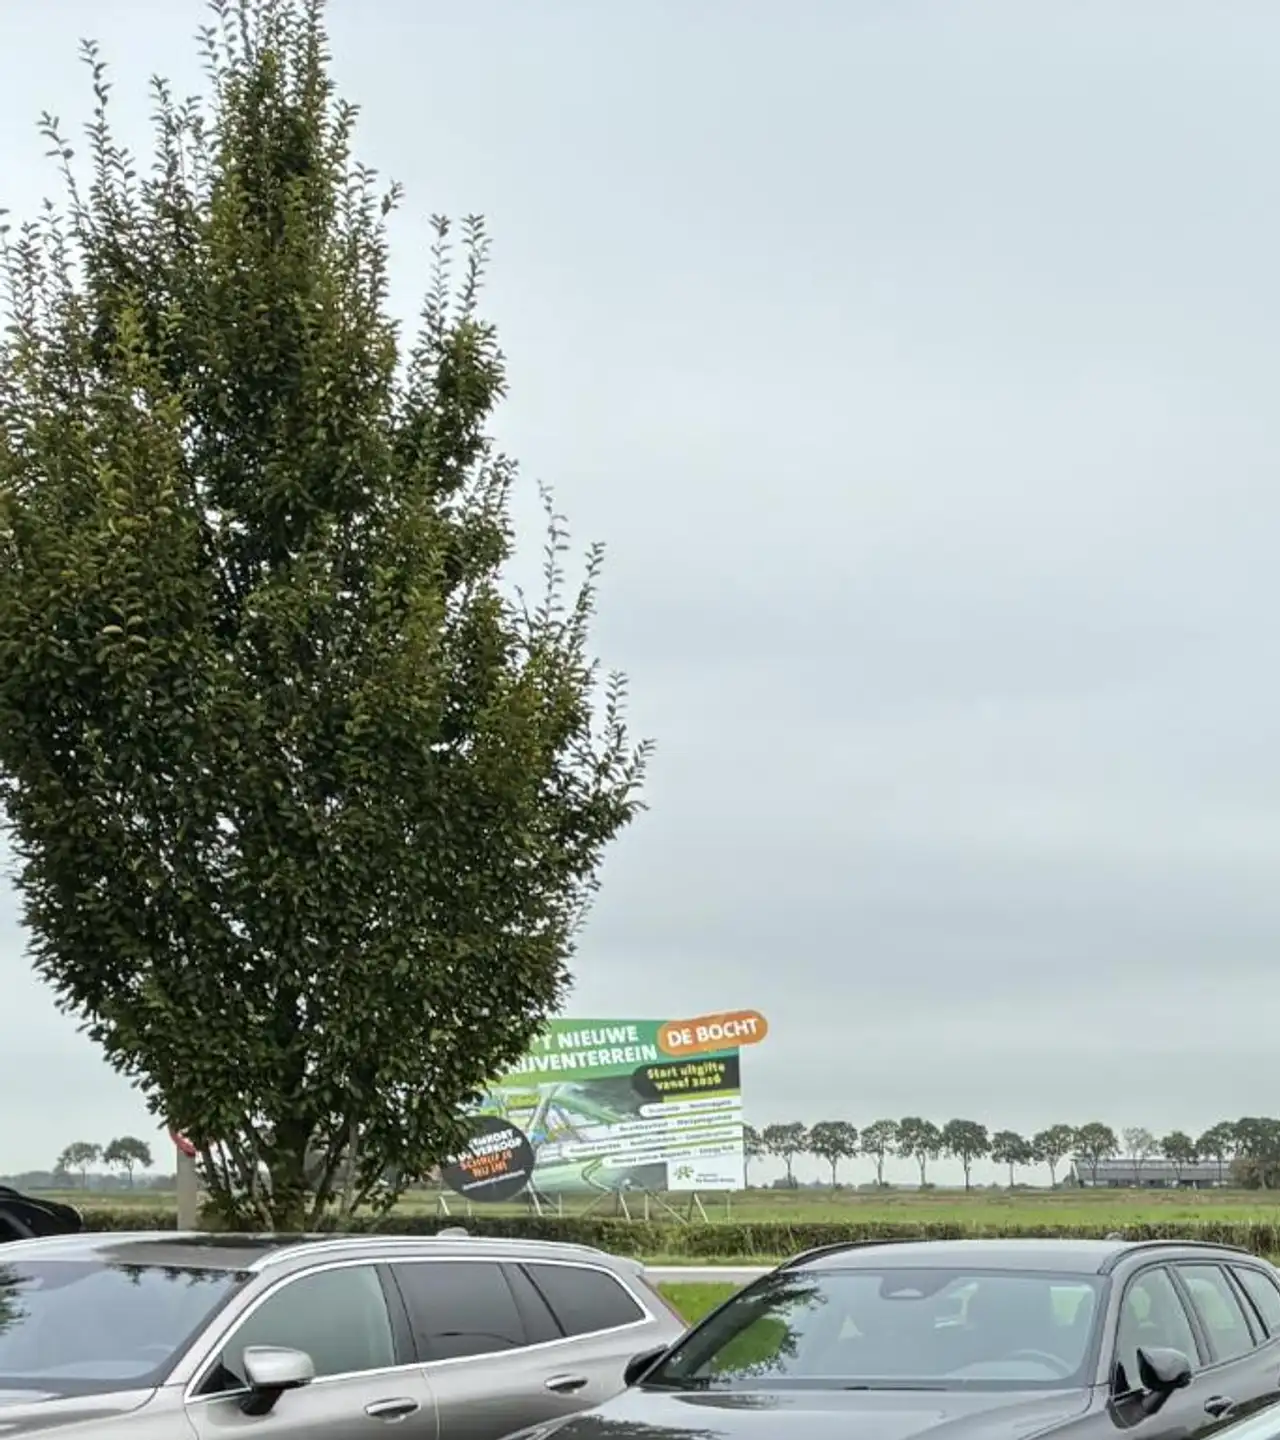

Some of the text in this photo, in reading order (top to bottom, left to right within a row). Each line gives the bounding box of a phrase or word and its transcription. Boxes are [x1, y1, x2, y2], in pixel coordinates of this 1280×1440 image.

[557, 1025, 639, 1050] NIEUWE
[666, 1018, 759, 1048] DE BOCHT
